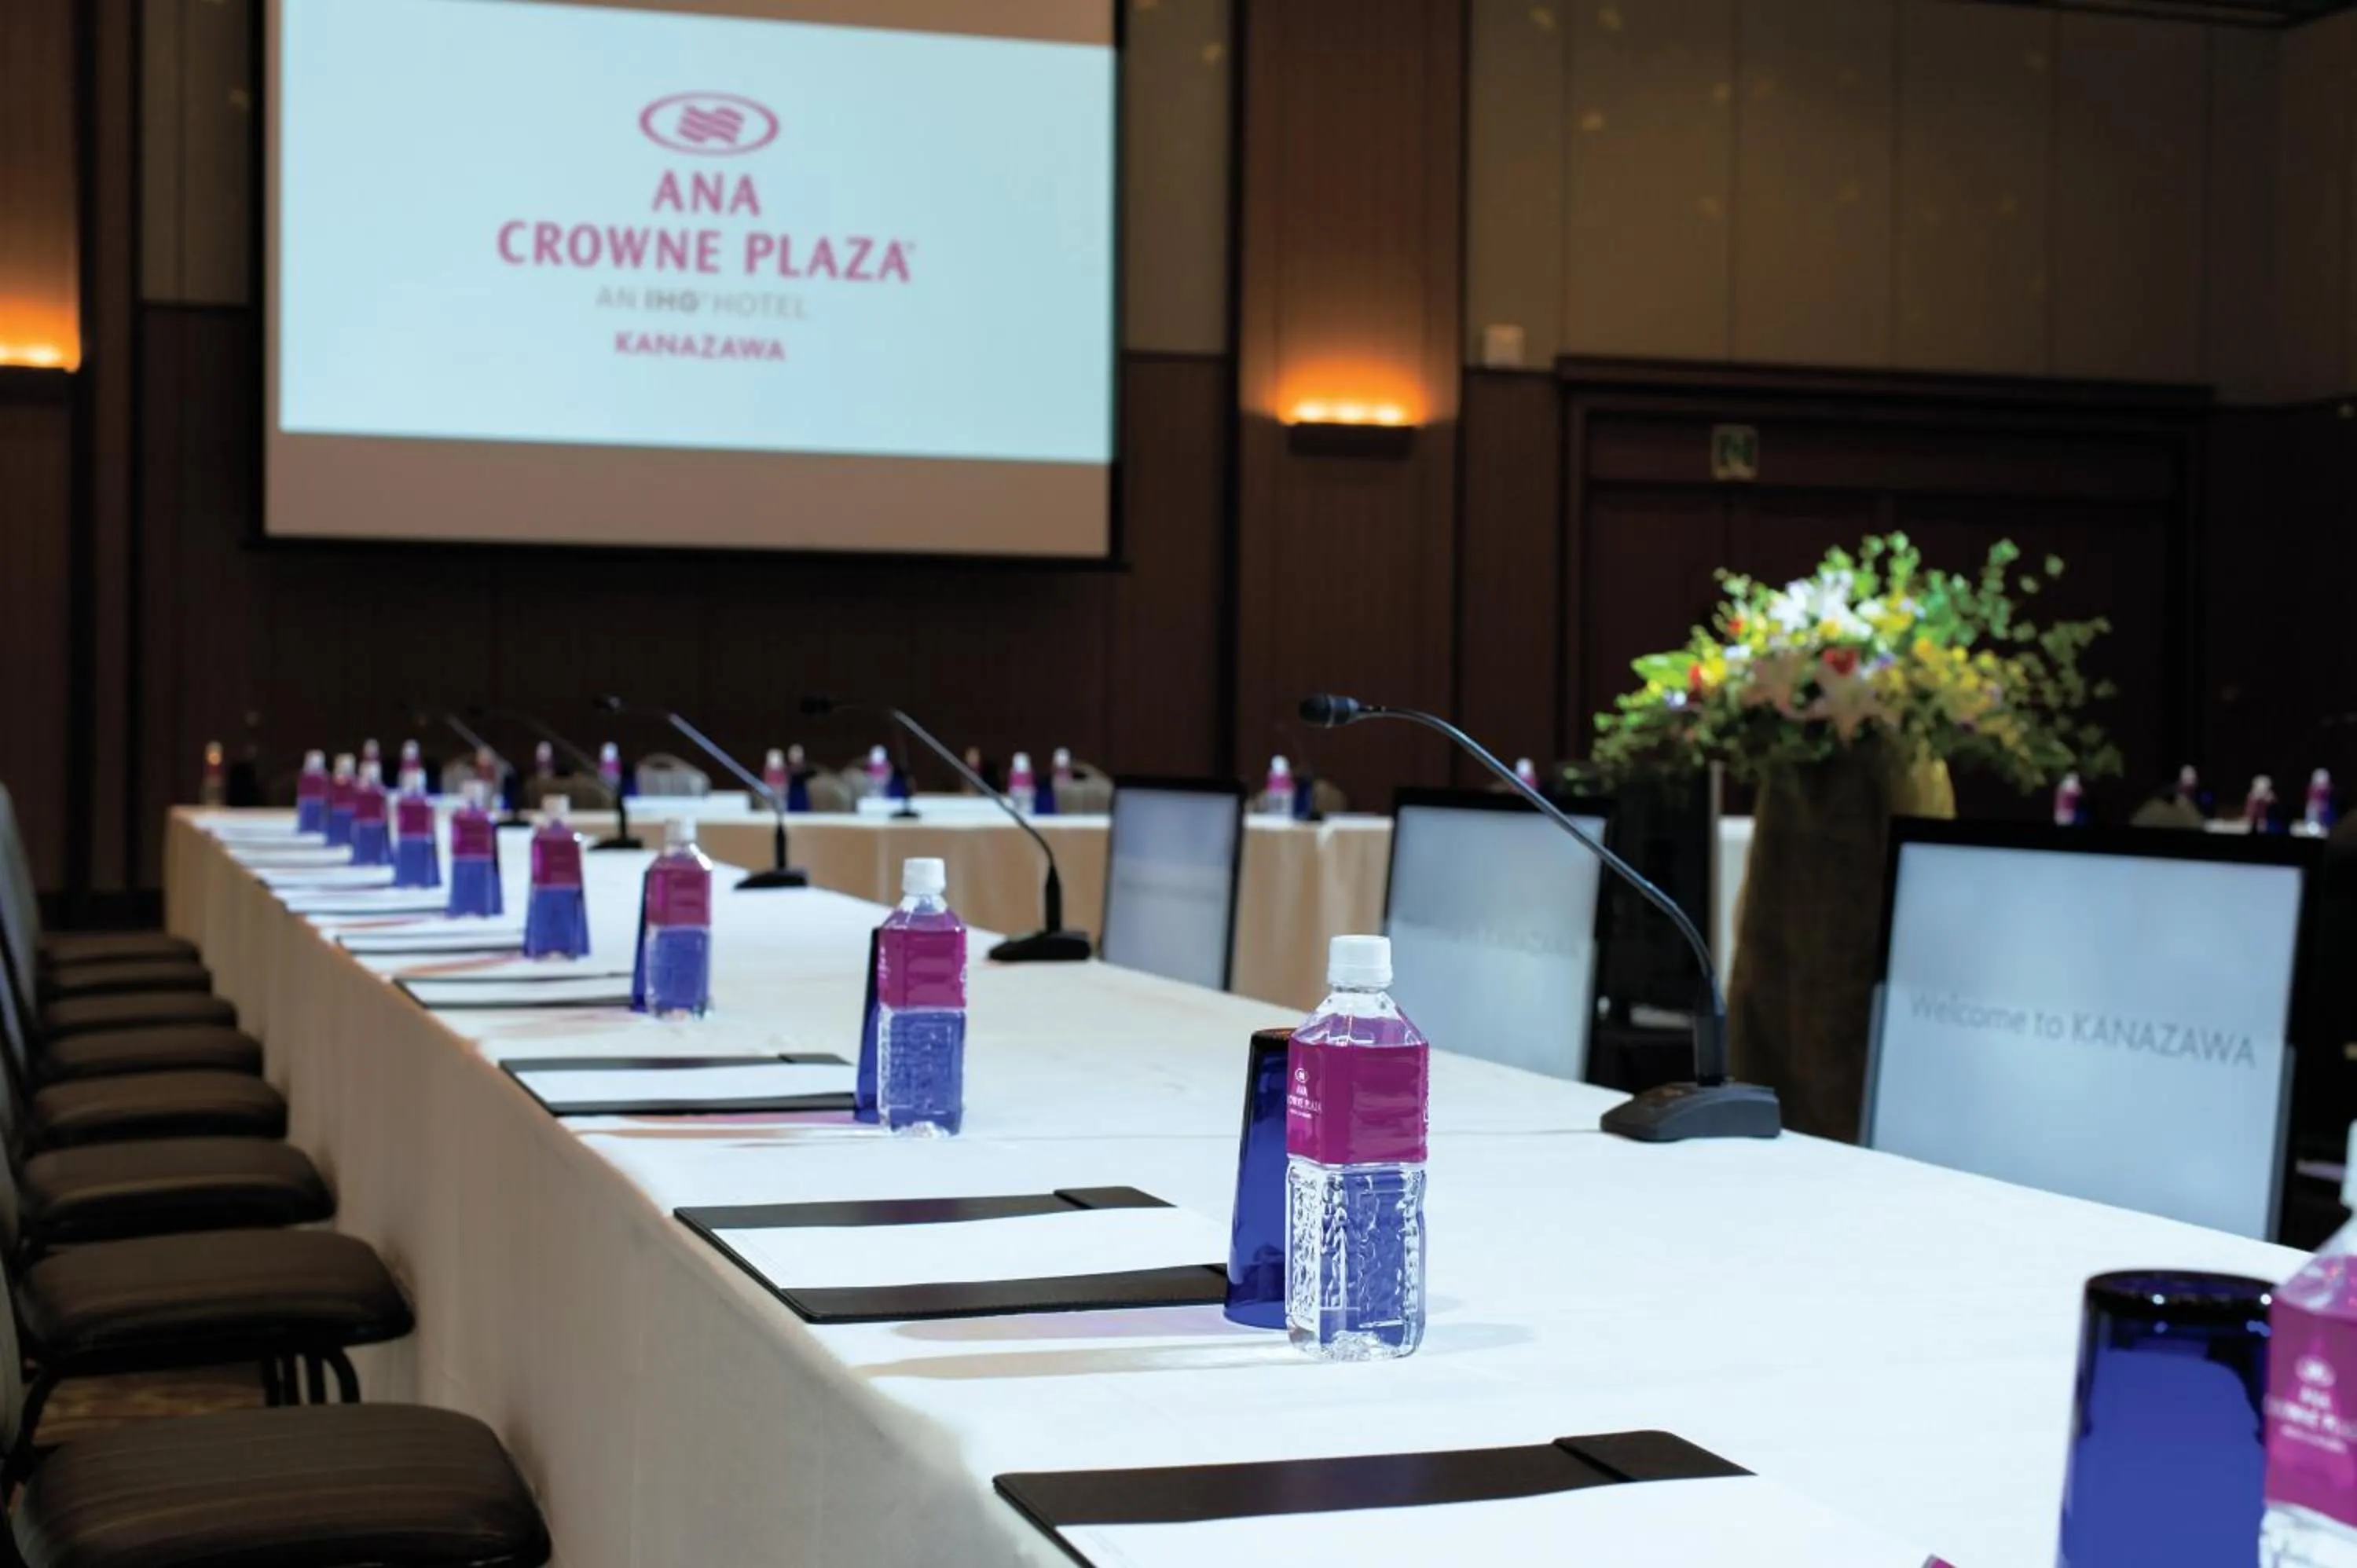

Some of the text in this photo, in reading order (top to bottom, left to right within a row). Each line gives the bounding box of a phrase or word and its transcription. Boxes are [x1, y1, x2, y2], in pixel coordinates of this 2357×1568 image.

[652, 169, 762, 217] ANA
[497, 220, 721, 273] CROWNE
[595, 286, 636, 310] AN
[713, 291, 809, 321] HOTEL
[614, 332, 786, 361] KANAZAWA
[1911, 991, 2257, 1068] Welcome to KANAZAWA
